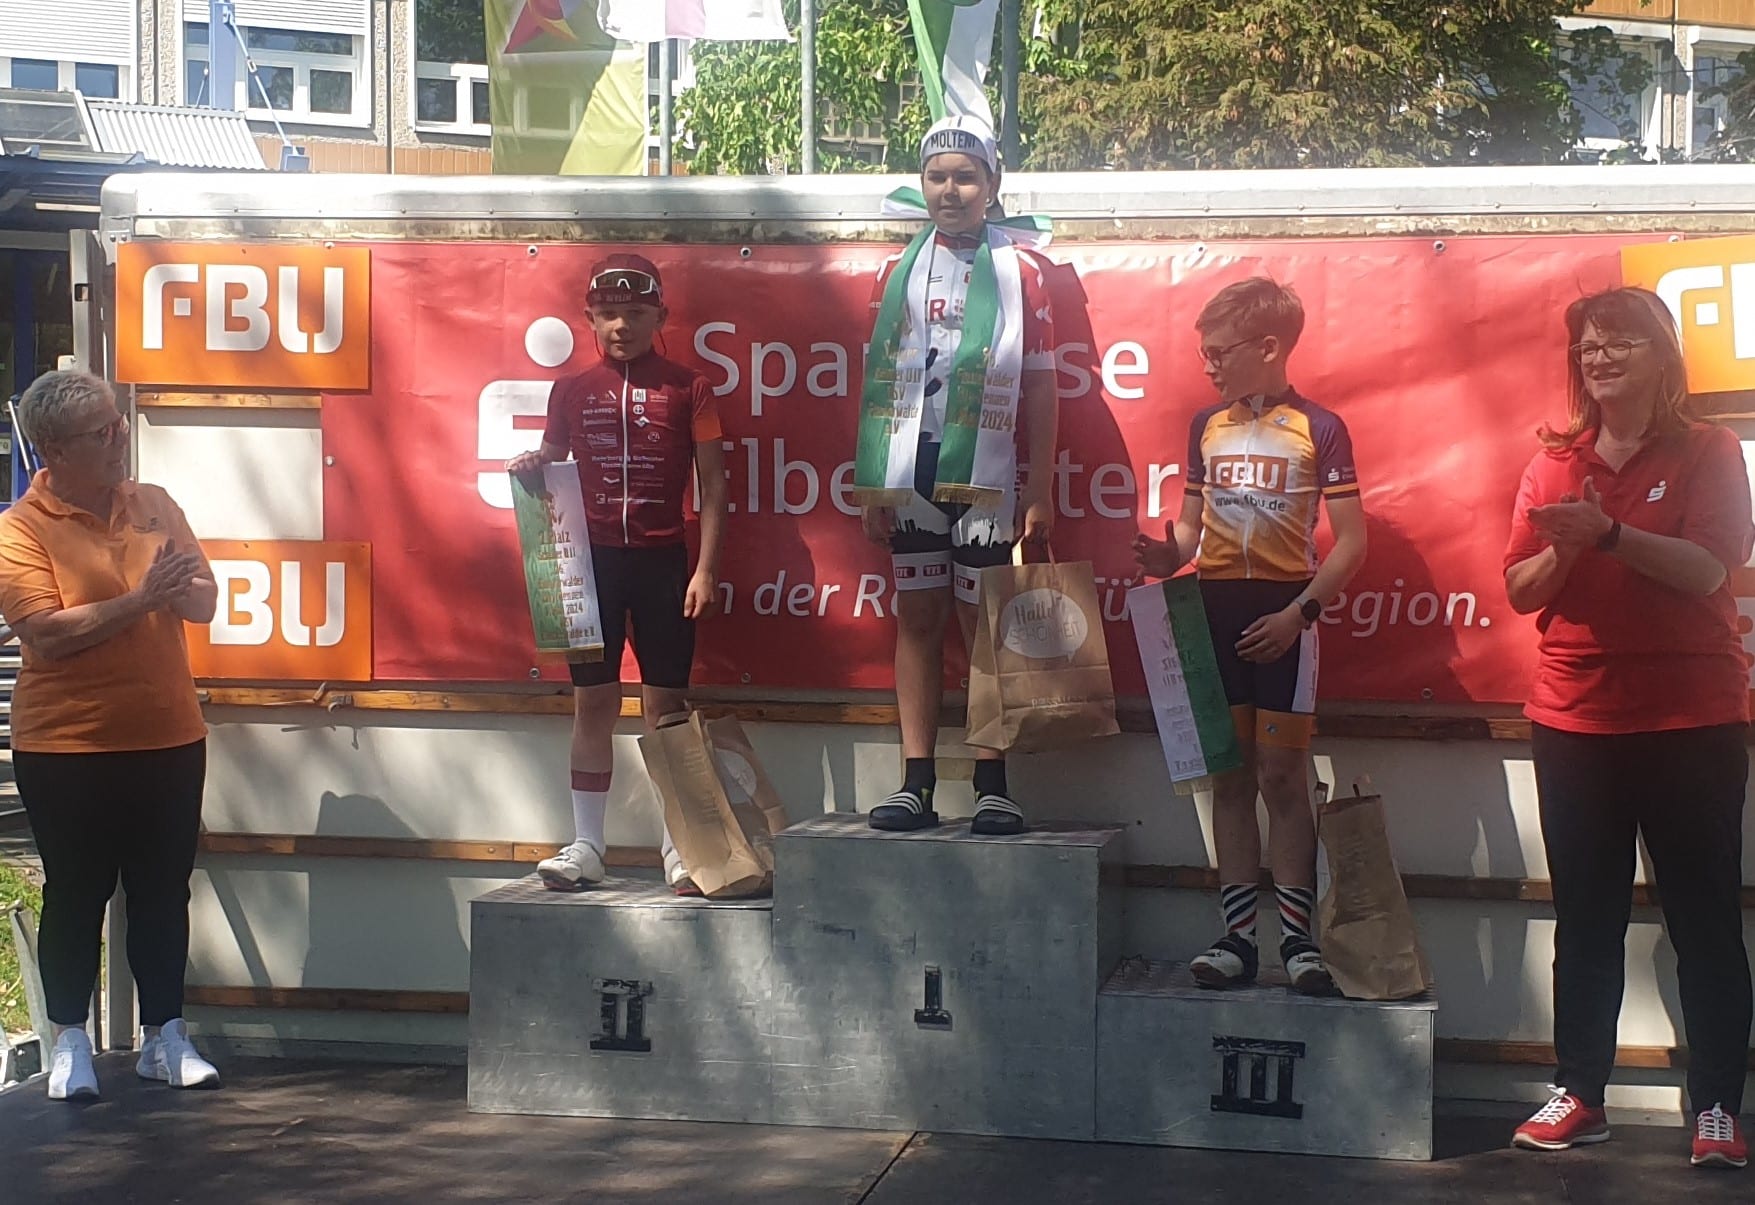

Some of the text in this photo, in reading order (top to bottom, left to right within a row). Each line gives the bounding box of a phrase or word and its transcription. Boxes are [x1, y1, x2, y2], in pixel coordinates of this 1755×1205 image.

[931, 131, 976, 148] MOLTENI
[142, 263, 344, 354] FBU
[980, 409, 1013, 432] 2024
[1215, 461, 1280, 489] FBU
[209, 560, 345, 646] BU
[753, 570, 831, 617] der
[1320, 578, 1491, 637] egion.
[590, 979, 652, 1052] II
[1211, 1035, 1305, 1119] III
